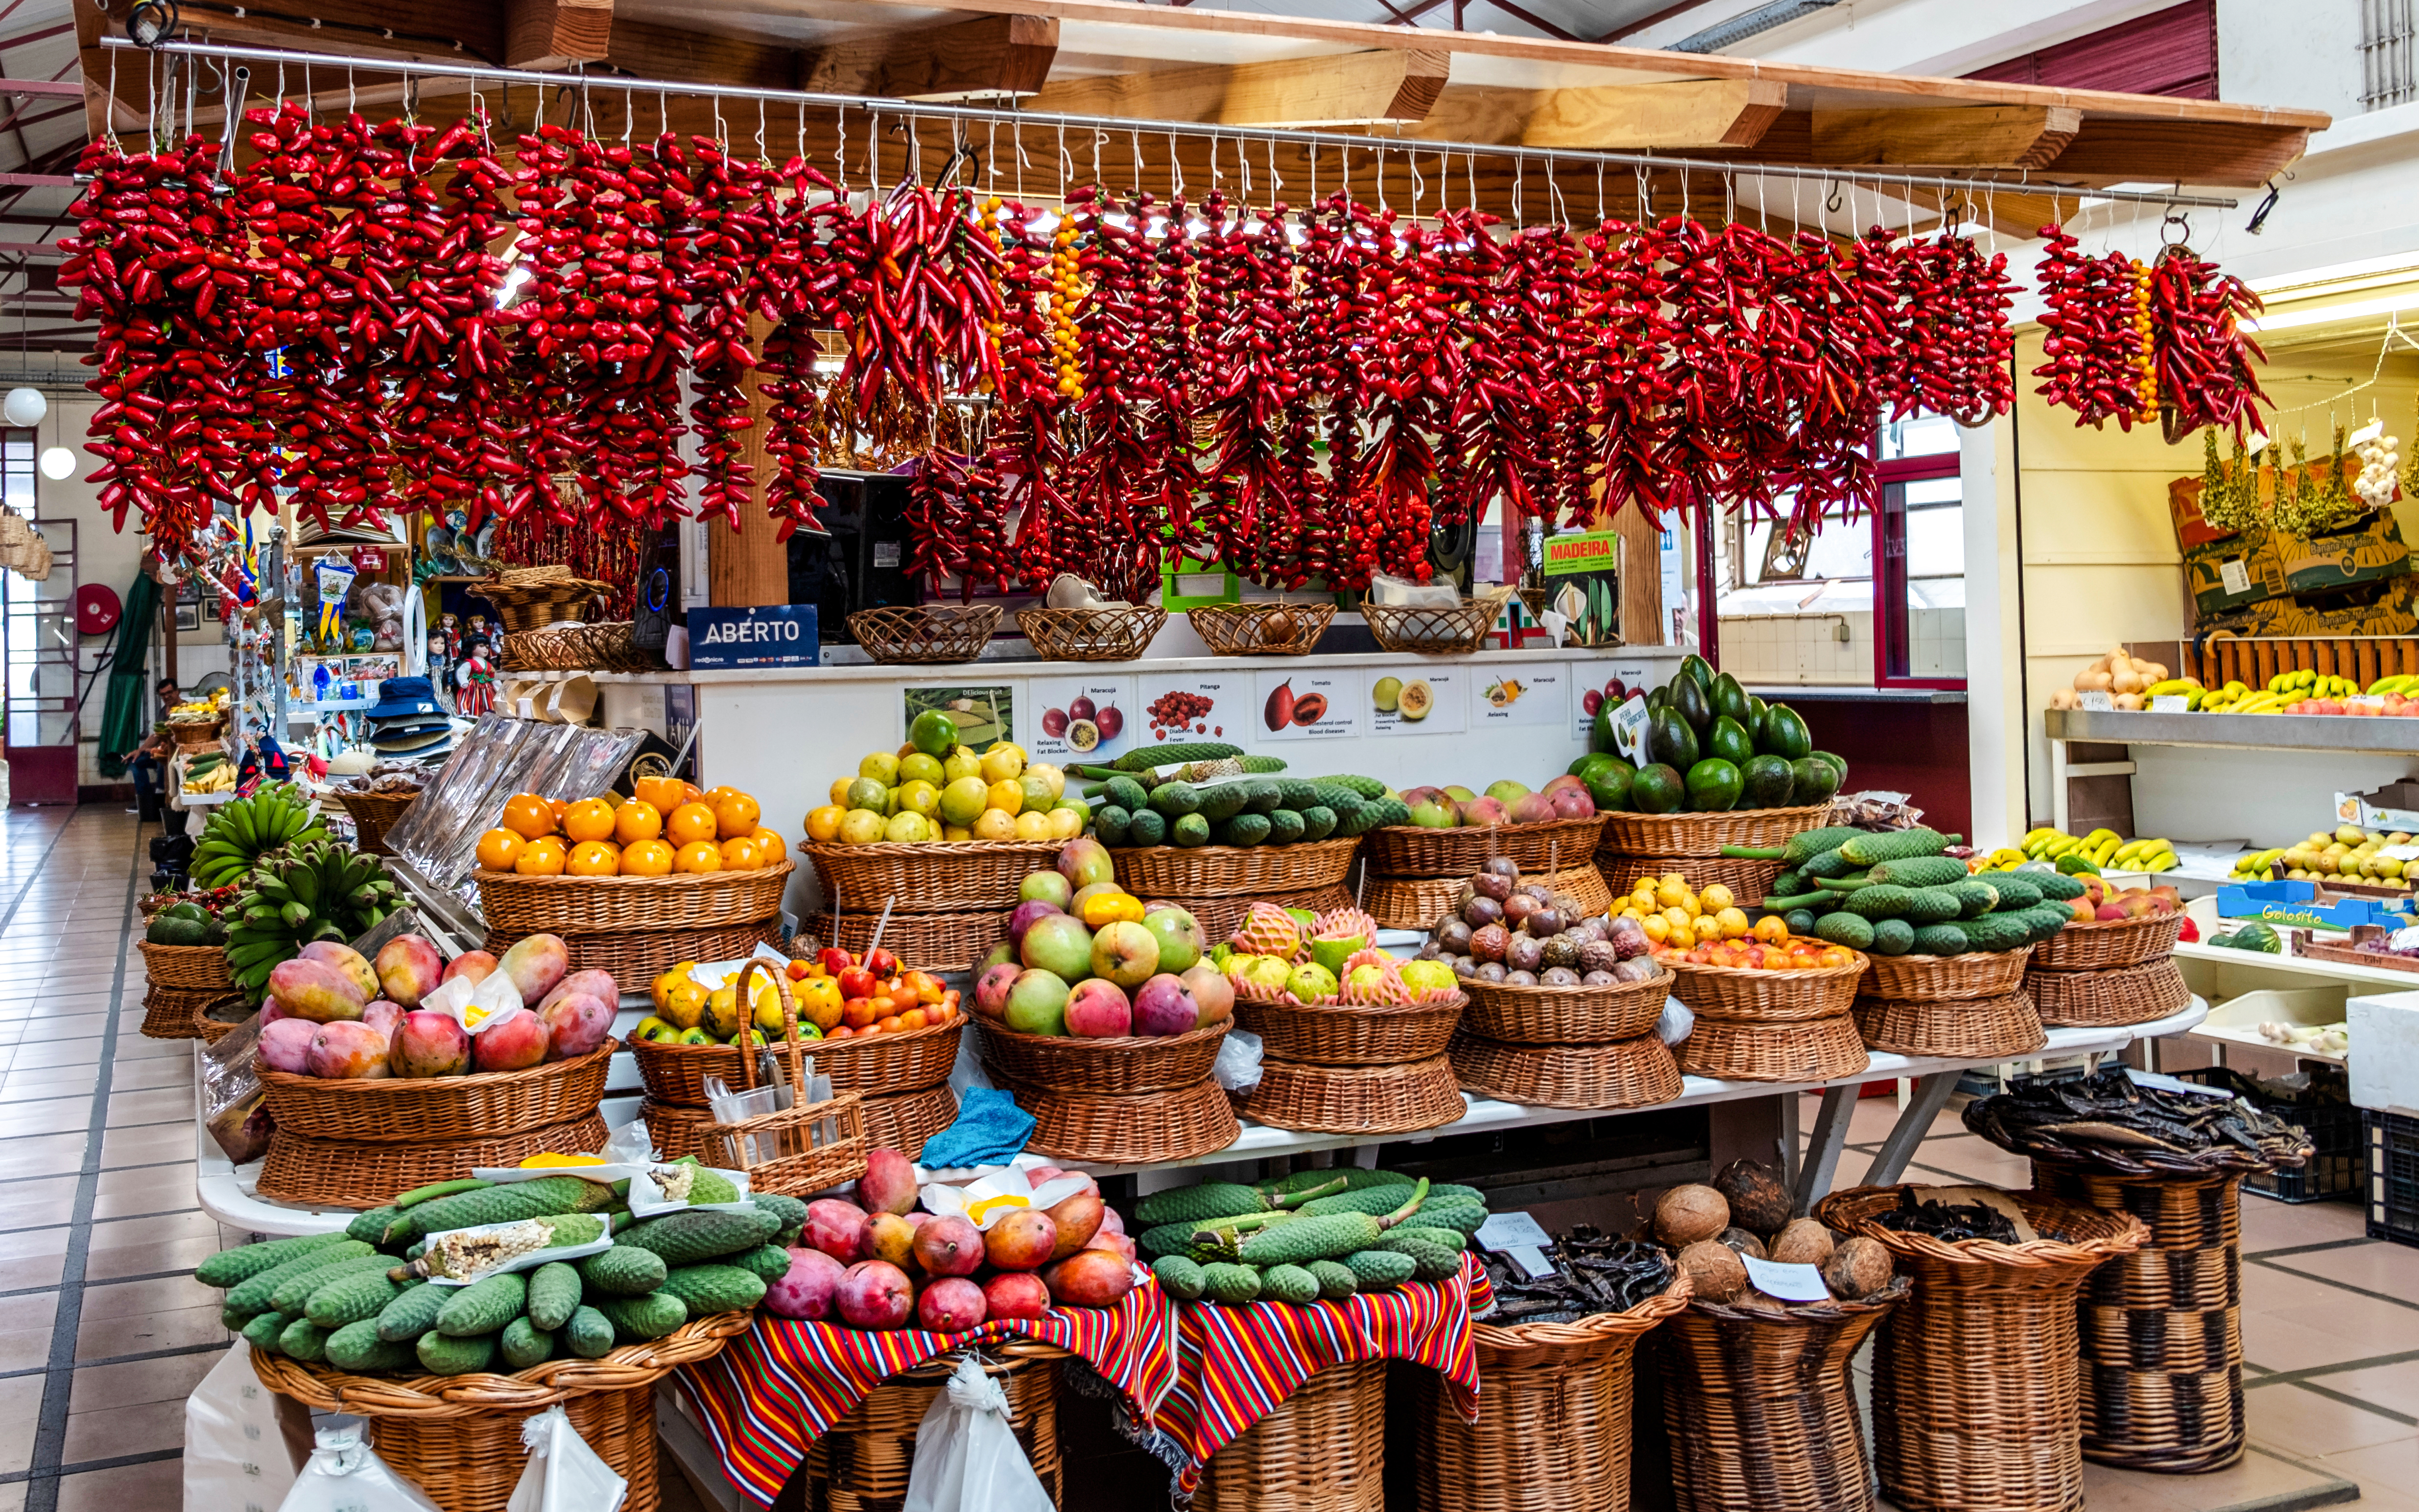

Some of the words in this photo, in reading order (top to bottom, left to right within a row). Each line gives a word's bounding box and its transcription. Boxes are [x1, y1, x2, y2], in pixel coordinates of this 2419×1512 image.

[1550, 540, 1610, 560] MADEIRA
[2201, 547, 2228, 561] Banana
[2233, 537, 2264, 551] Madeira
[2310, 543, 2340, 555] Banana
[2346, 537, 2377, 548] Madeira
[2241, 612, 2272, 624] Madeira
[2319, 614, 2348, 627] Banana
[2355, 608, 2387, 619] Madeira
[705, 620, 799, 643] ABERTO
[2262, 904, 2322, 924] Golosito
